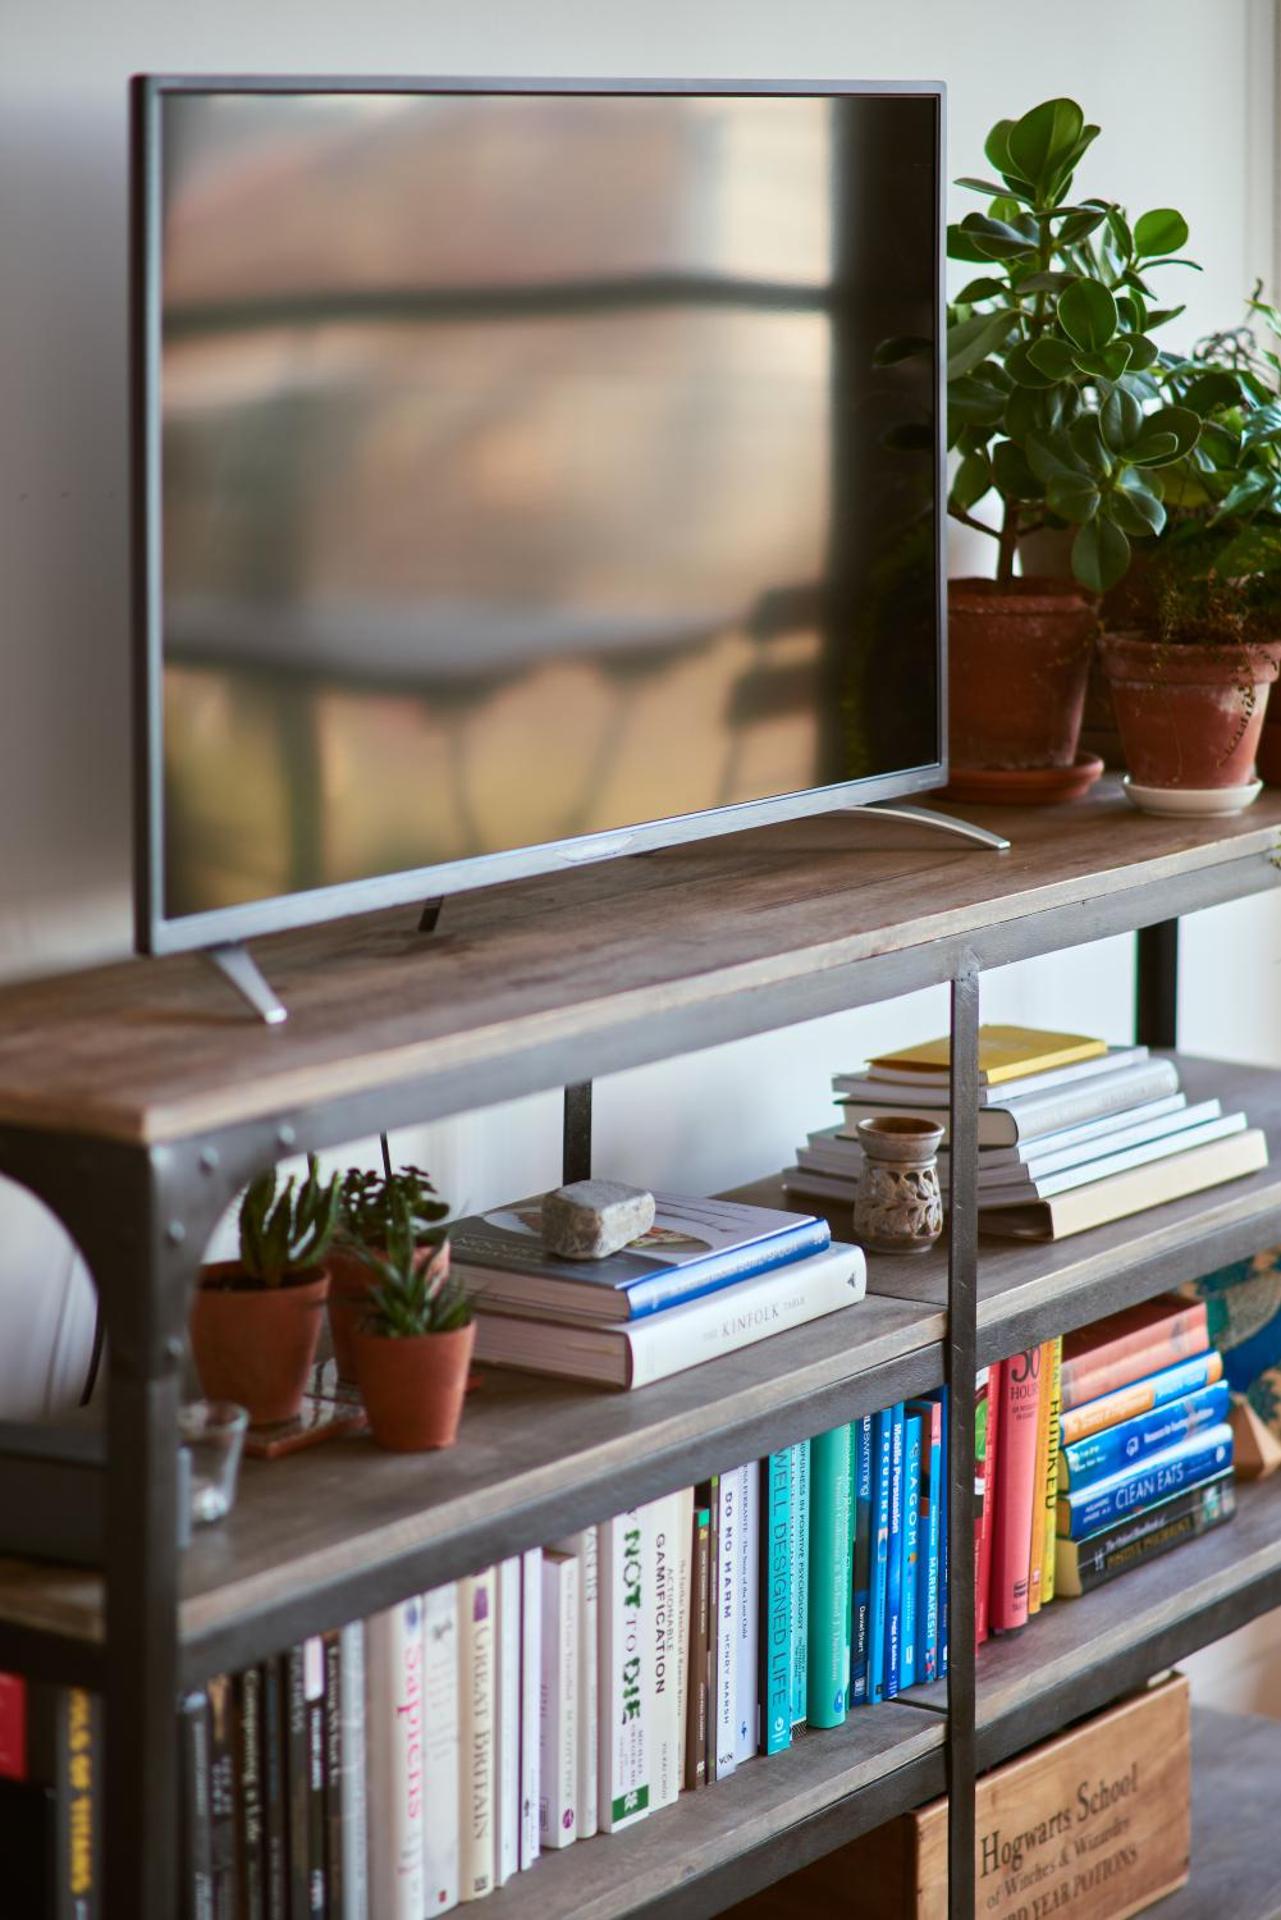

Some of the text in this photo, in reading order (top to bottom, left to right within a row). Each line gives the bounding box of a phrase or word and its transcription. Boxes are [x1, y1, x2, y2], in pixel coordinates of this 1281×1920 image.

[721, 1304, 779, 1336] KINFOLK
[893, 1423, 903, 1465] Mobile
[891, 1466, 901, 1534] Persuasion
[907, 1461, 919, 1546] LAGOM
[1115, 1462, 1184, 1510] CLEAN EATS
[623, 1528, 642, 1609] NOT
[798, 1514, 806, 1559] POSITIVE
[655, 1532, 666, 1695] GAMIFICATION
[666, 1568, 675, 1653] ACTIONABLE
[722, 1491, 734, 1725] DO NO HARM HENRY MARSH
[773, 1522, 788, 1646] DESIGNED
[926, 1556, 937, 1638] MARRAKESH
[625, 1612, 638, 1652] TO
[621, 1656, 642, 1726] DIE
[772, 1651, 787, 1707] LIFE
[395, 1643, 423, 1820] Sapiens
[472, 1625, 491, 1842] GREAT BRITAIN
[979, 1761, 1138, 1879] Hogwarts School
[1003, 1863, 1056, 1897] Witches
[1031, 1882, 1071, 1920] YEAR
[1072, 1844, 1138, 1898] POTIONS
